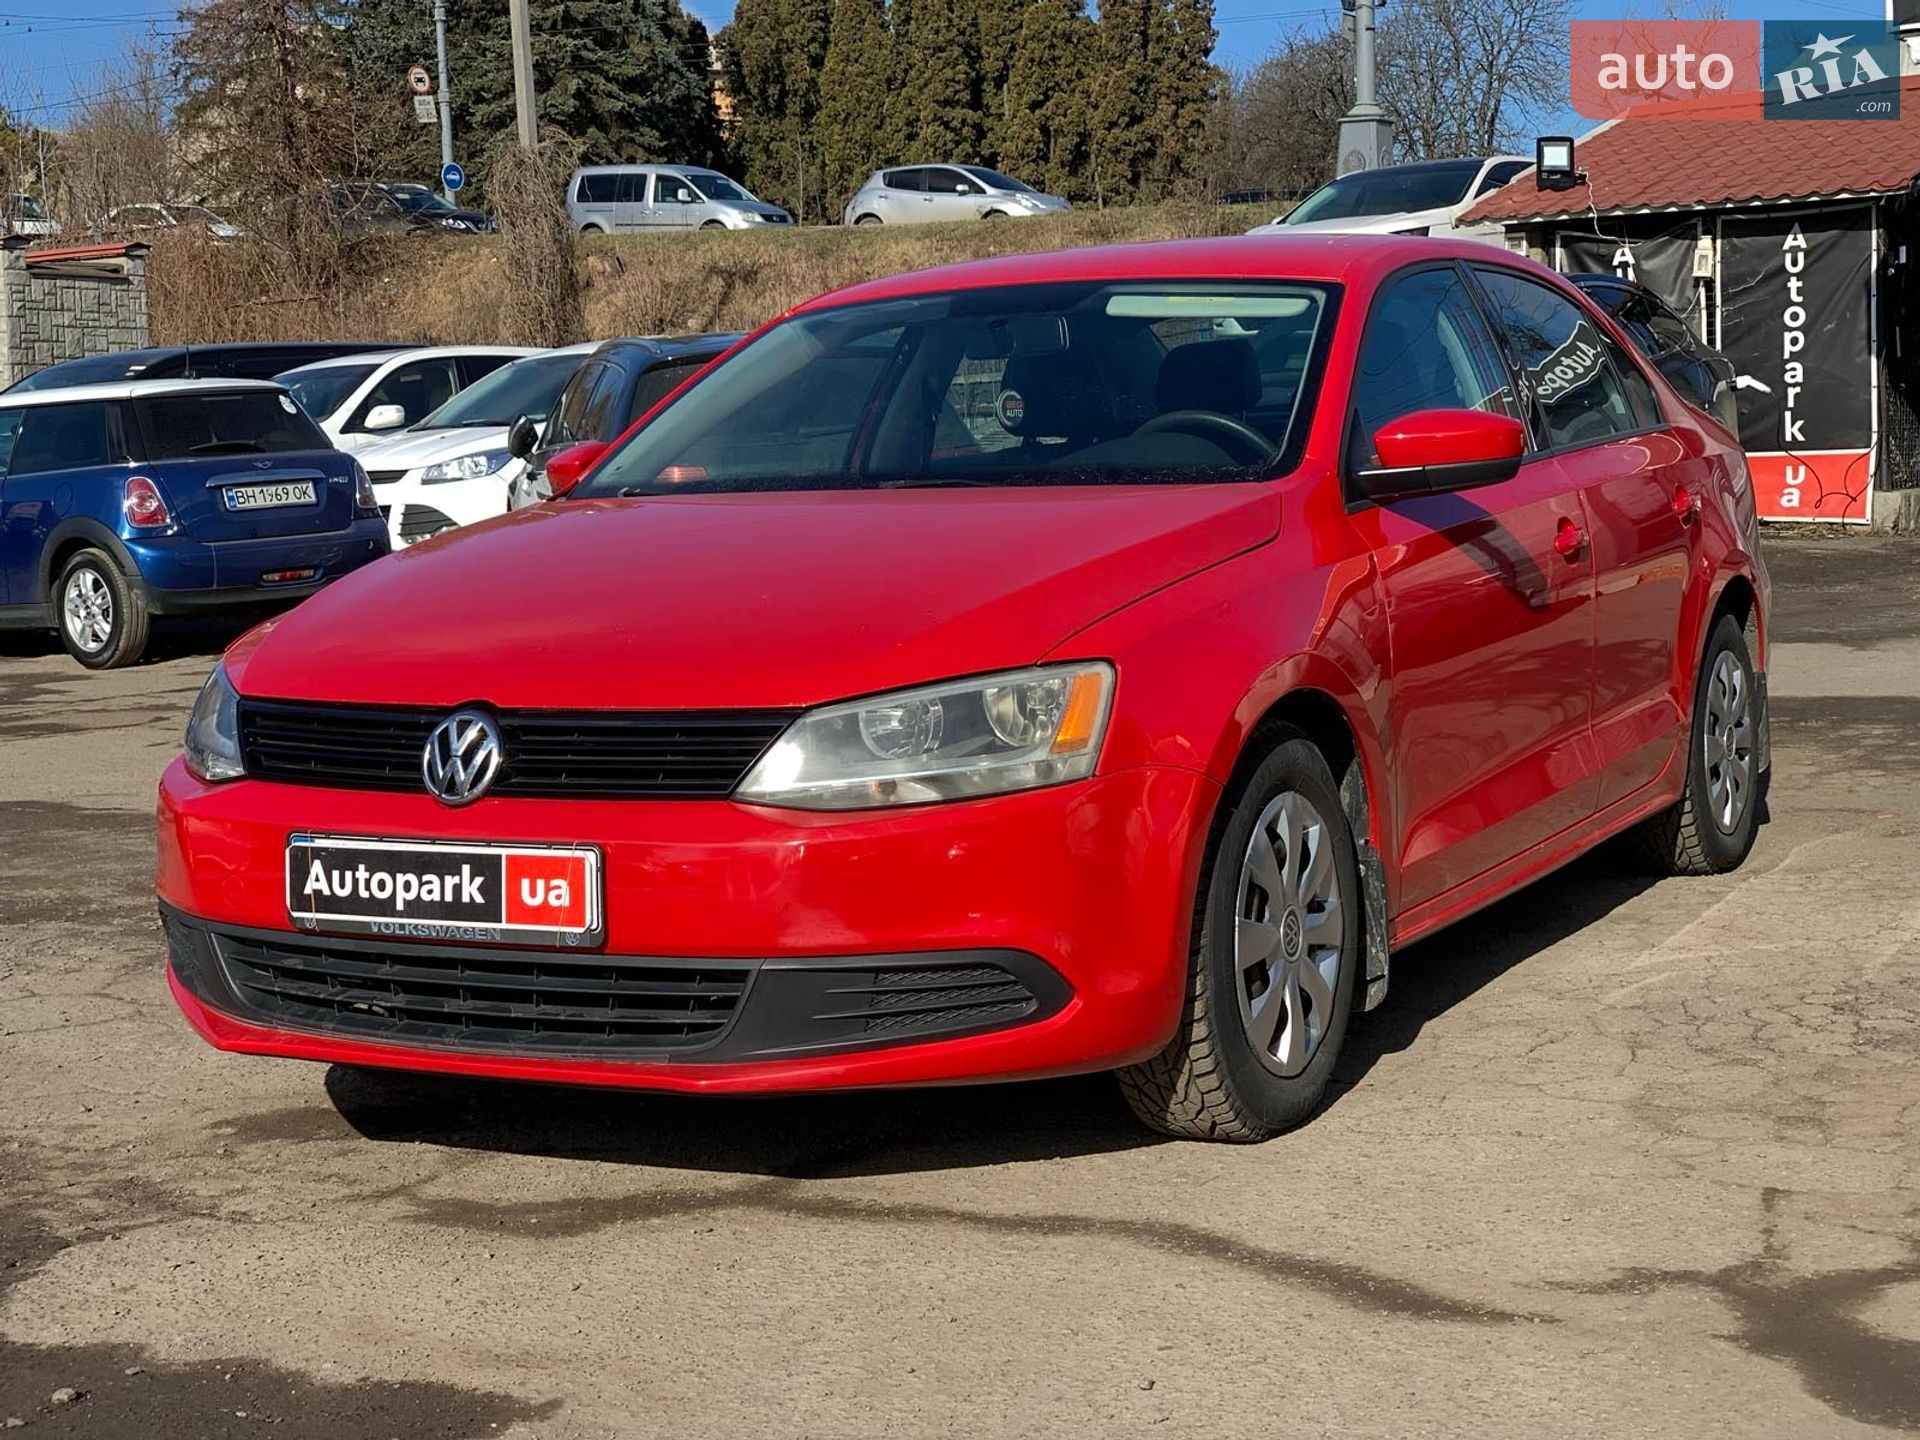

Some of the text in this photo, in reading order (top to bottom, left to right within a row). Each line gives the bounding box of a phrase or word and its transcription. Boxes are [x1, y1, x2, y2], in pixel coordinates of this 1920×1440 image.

[1780, 222, 1808, 508] Autopark ua
[235, 489, 257, 505] BH
[293, 484, 313, 500] OK
[303, 859, 570, 911] Autopark ua
[370, 921, 501, 941] VOLKSWAGEN
